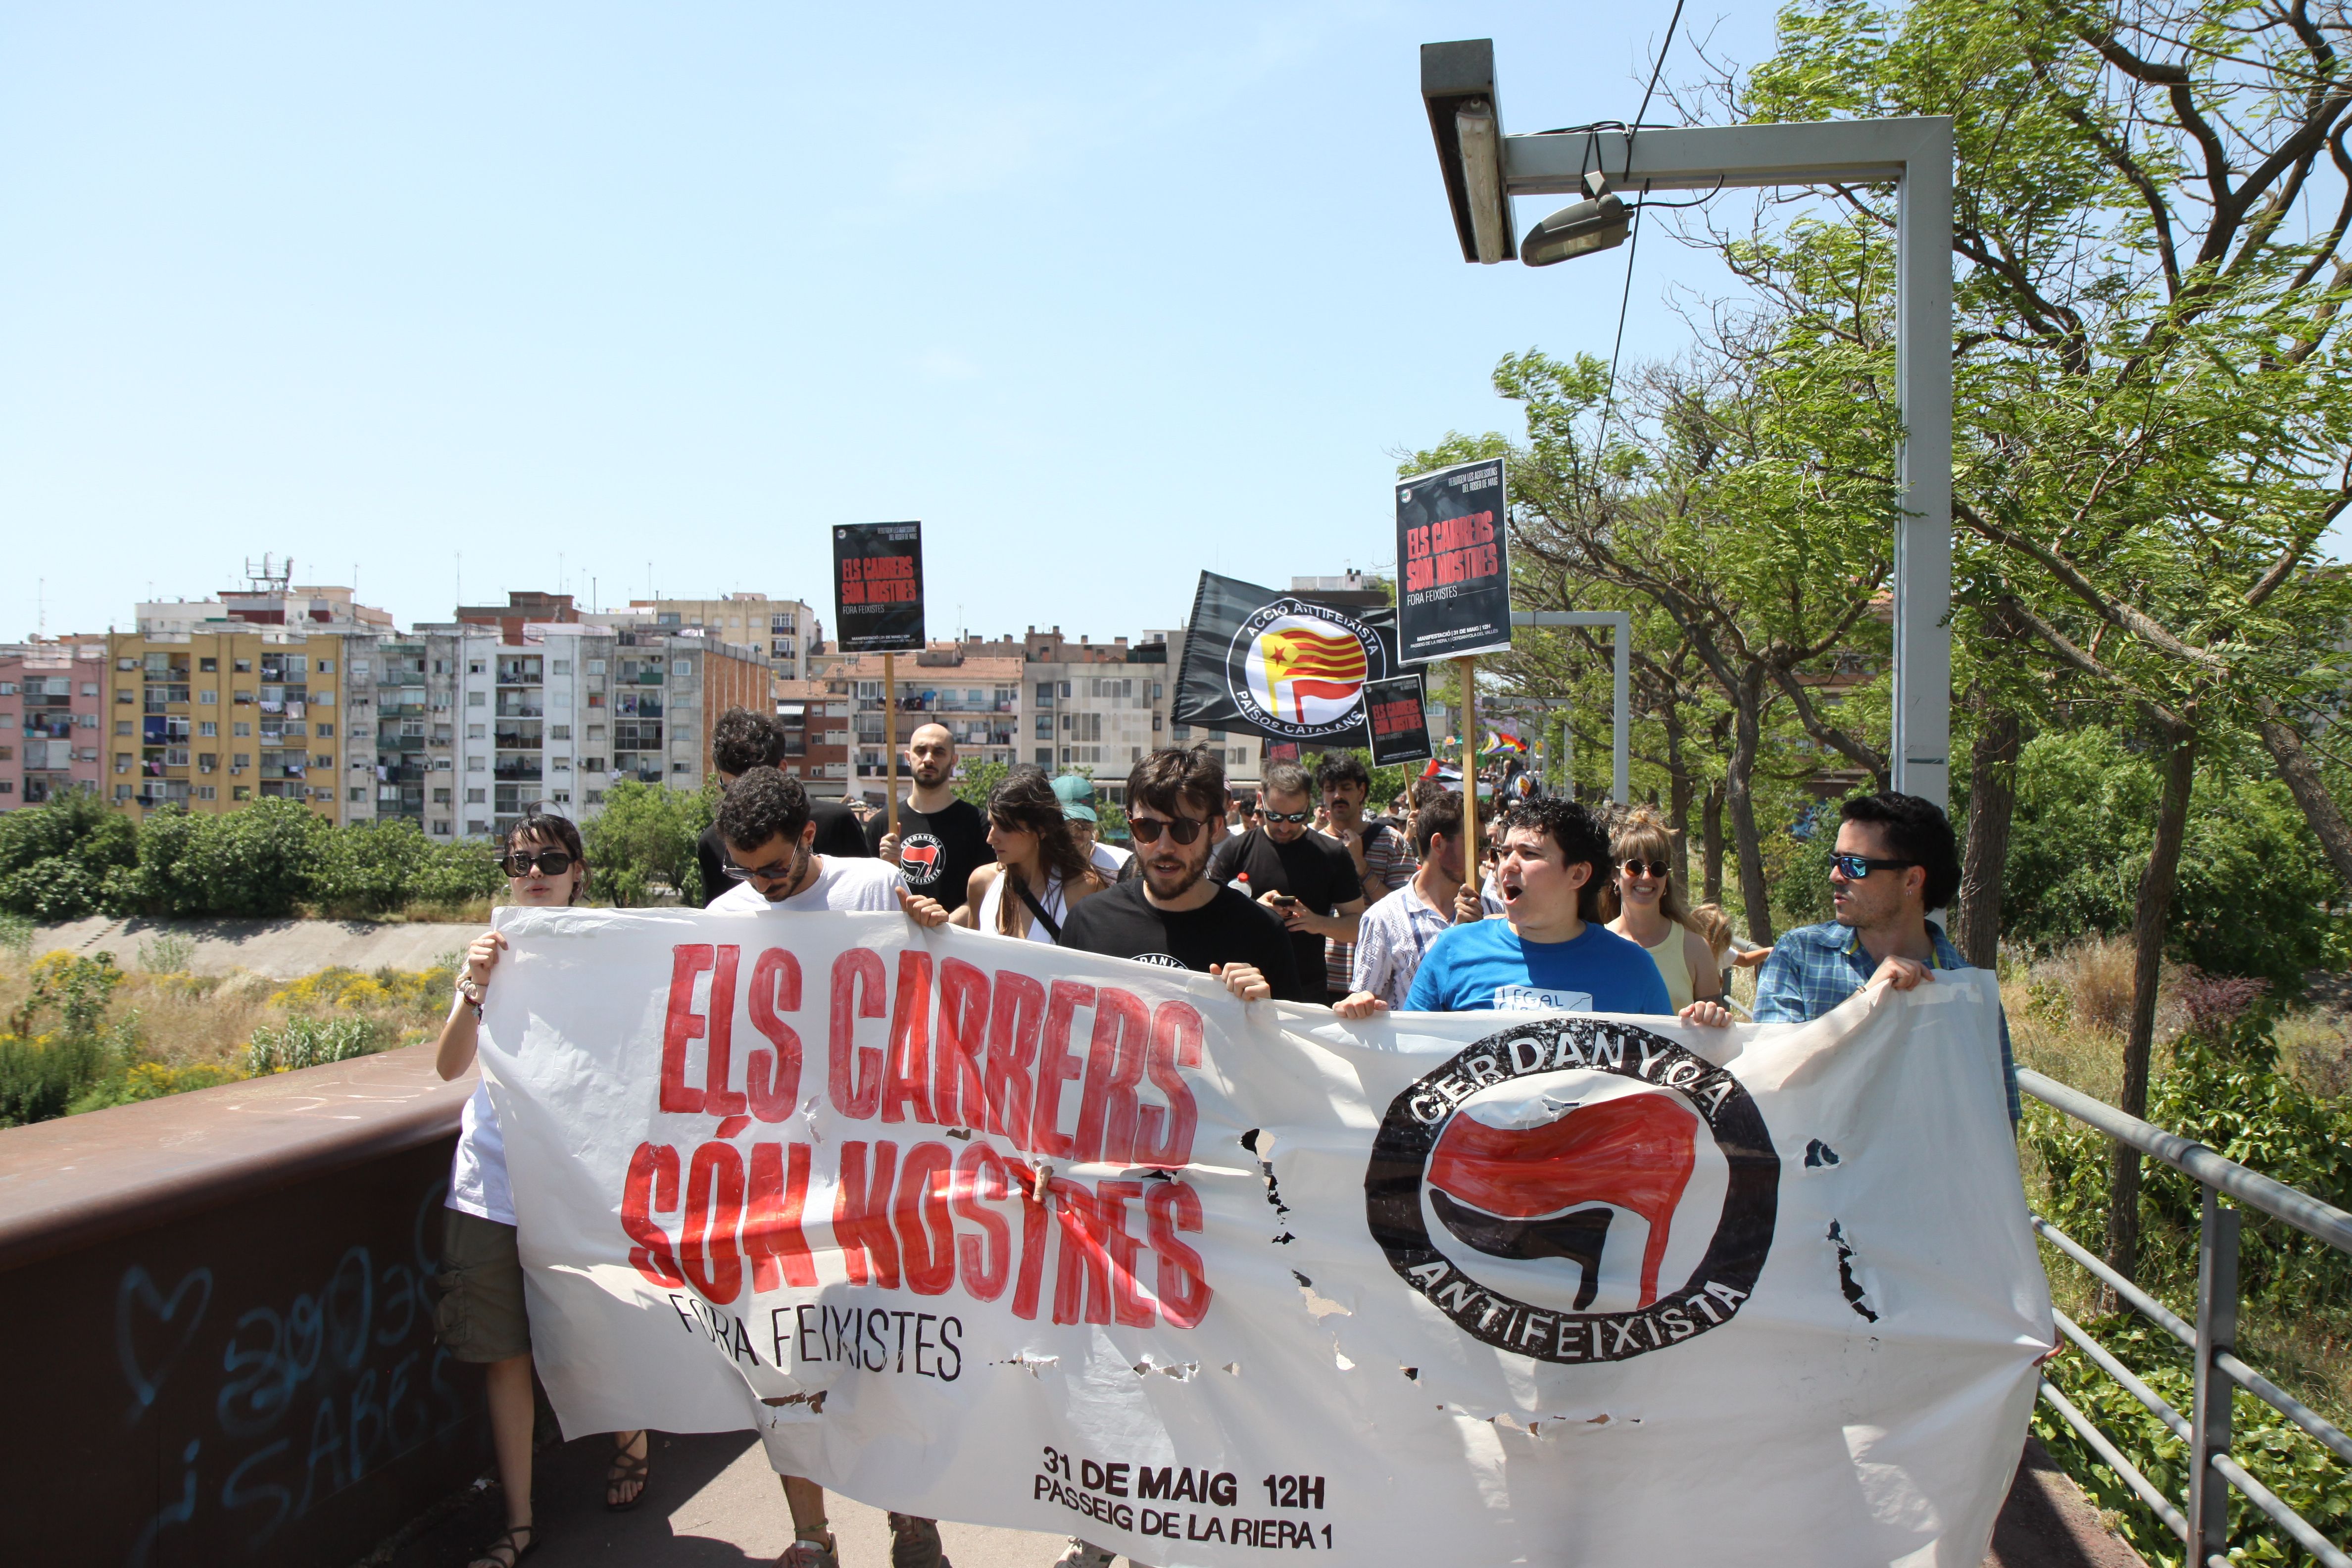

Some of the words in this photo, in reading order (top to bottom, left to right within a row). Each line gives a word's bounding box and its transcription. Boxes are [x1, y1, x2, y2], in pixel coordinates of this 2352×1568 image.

[1448, 474, 1467, 487] REBUTGEM
[1474, 467, 1497, 480] AGRESSIONS
[1470, 480, 1481, 491] ROSER
[1482, 479, 1487, 488] DE
[1488, 477, 1498, 487] MAIG
[1407, 526, 1429, 560] ELS
[1431, 511, 1494, 554] CARRERS
[842, 558, 861, 581] ELS
[863, 556, 913, 580] CARRERS
[1436, 543, 1498, 586] NOSTRES
[867, 579, 917, 603] NOSTRES
[1407, 591, 1424, 606] FORA
[1426, 586, 1457, 602] FEIXISTES
[843, 606, 857, 614] FORA
[859, 605, 884, 613] FEIXISTES
[1247, 603, 1288, 637] ACCIÓ
[1417, 630, 1451, 641] MANIFESTACIÓ
[1452, 633, 1476, 641] CERDANYOLA
[1237, 690, 1280, 728] PAÏSOS
[1284, 710, 1363, 734] CATALANS
[1372, 704, 1386, 720] ELS
[901, 835, 942, 849] CERDANYOLA
[900, 868, 940, 883] ANTIFEIXISTA
[659, 944, 801, 1123] ELS
[829, 947, 1203, 1169] CARRERS
[621, 1115, 819, 1305] SÓN
[833, 1140, 1213, 1329] NOSTRES
[1409, 1260, 1751, 1358] ANTIFEIXISTA
[669, 1293, 759, 1367] FORA
[773, 1305, 963, 1382] FEIXISTES
[1043, 1446, 1071, 1481] 31
[1081, 1459, 1130, 1497] DE
[1138, 1467, 1237, 1506] MAIG
[1263, 1474, 1325, 1510] 12H
[1034, 1474, 1133, 1532] PASSEIG
[1141, 1508, 1180, 1539] DE
[1188, 1514, 1225, 1542] LA
[1231, 1518, 1317, 1550] RIERA
[1321, 1523, 1332, 1549] 1
